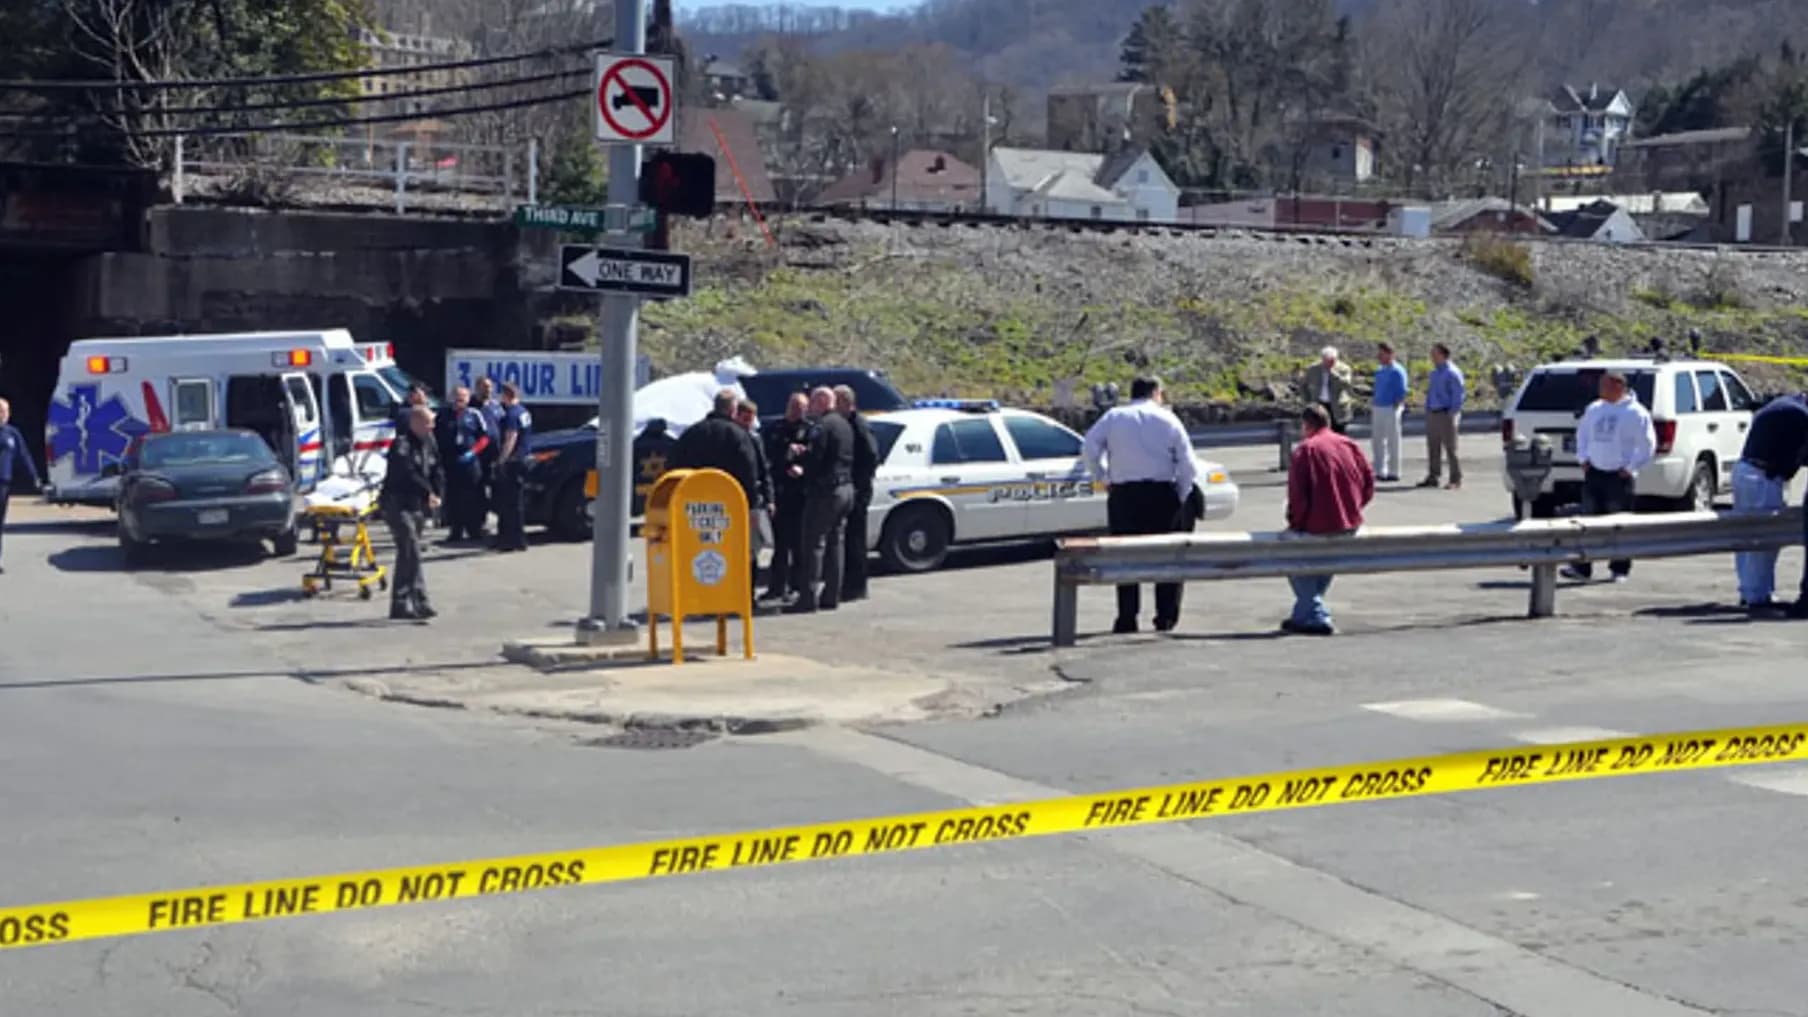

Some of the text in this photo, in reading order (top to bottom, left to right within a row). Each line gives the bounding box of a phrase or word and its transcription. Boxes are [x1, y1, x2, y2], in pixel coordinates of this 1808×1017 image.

[525, 206, 600, 228] THIRD AVE
[600, 259, 676, 283] ONE WAY
[457, 361, 471, 388] 3
[486, 361, 555, 395] HOUR
[986, 480, 1094, 503] POLICE
[0, 732, 1806, 945] OSS FIRE LINE DO NOT CROSS FIRE LINE DO NOT CROSS FIRE LINE DO NOT CROSS FIRE LINE DO NOT CROSS
